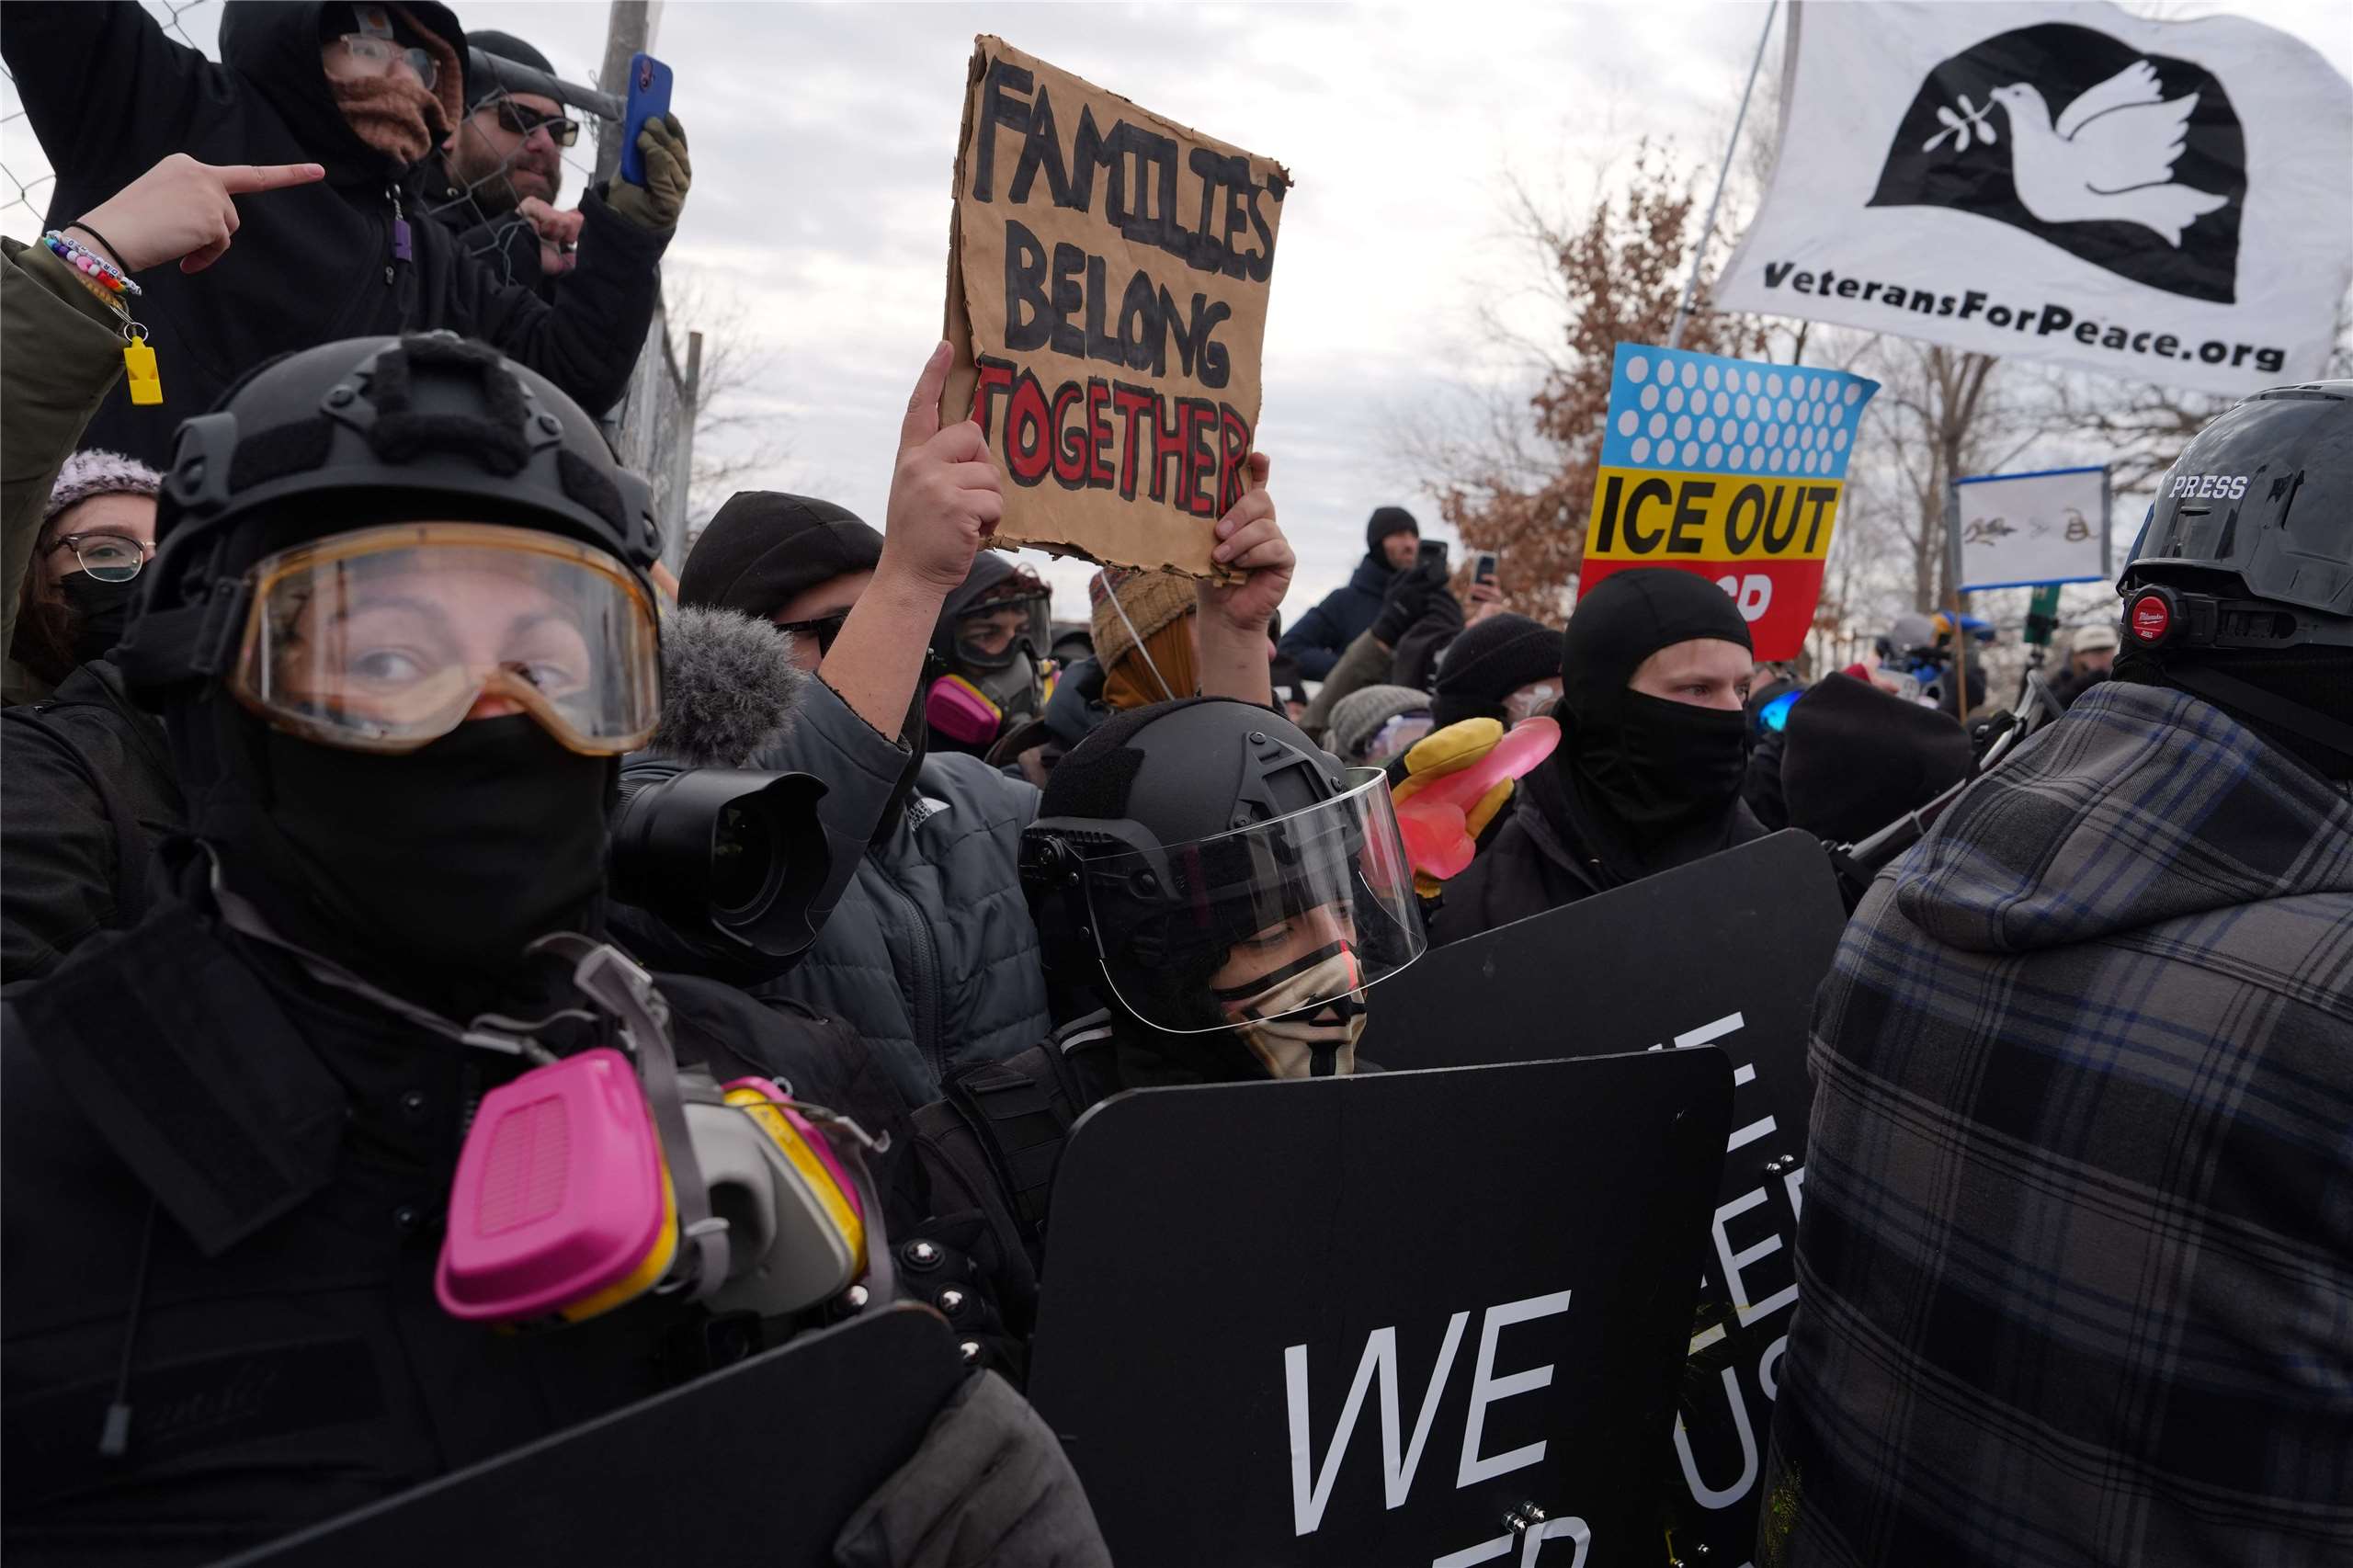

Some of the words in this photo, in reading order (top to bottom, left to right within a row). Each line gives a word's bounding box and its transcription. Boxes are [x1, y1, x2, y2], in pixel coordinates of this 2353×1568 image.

[972, 56, 1286, 283] FAMILIES
[1004, 219, 1232, 389] BELONG
[1764, 261, 2286, 373] VeteransForPeace.org
[971, 351, 1251, 521] TOGETHER
[1595, 475, 1717, 555] ICE
[1723, 483, 1838, 556] OUT
[2169, 474, 2249, 500] PRESS
[1284, 1289, 1572, 1538] WE
